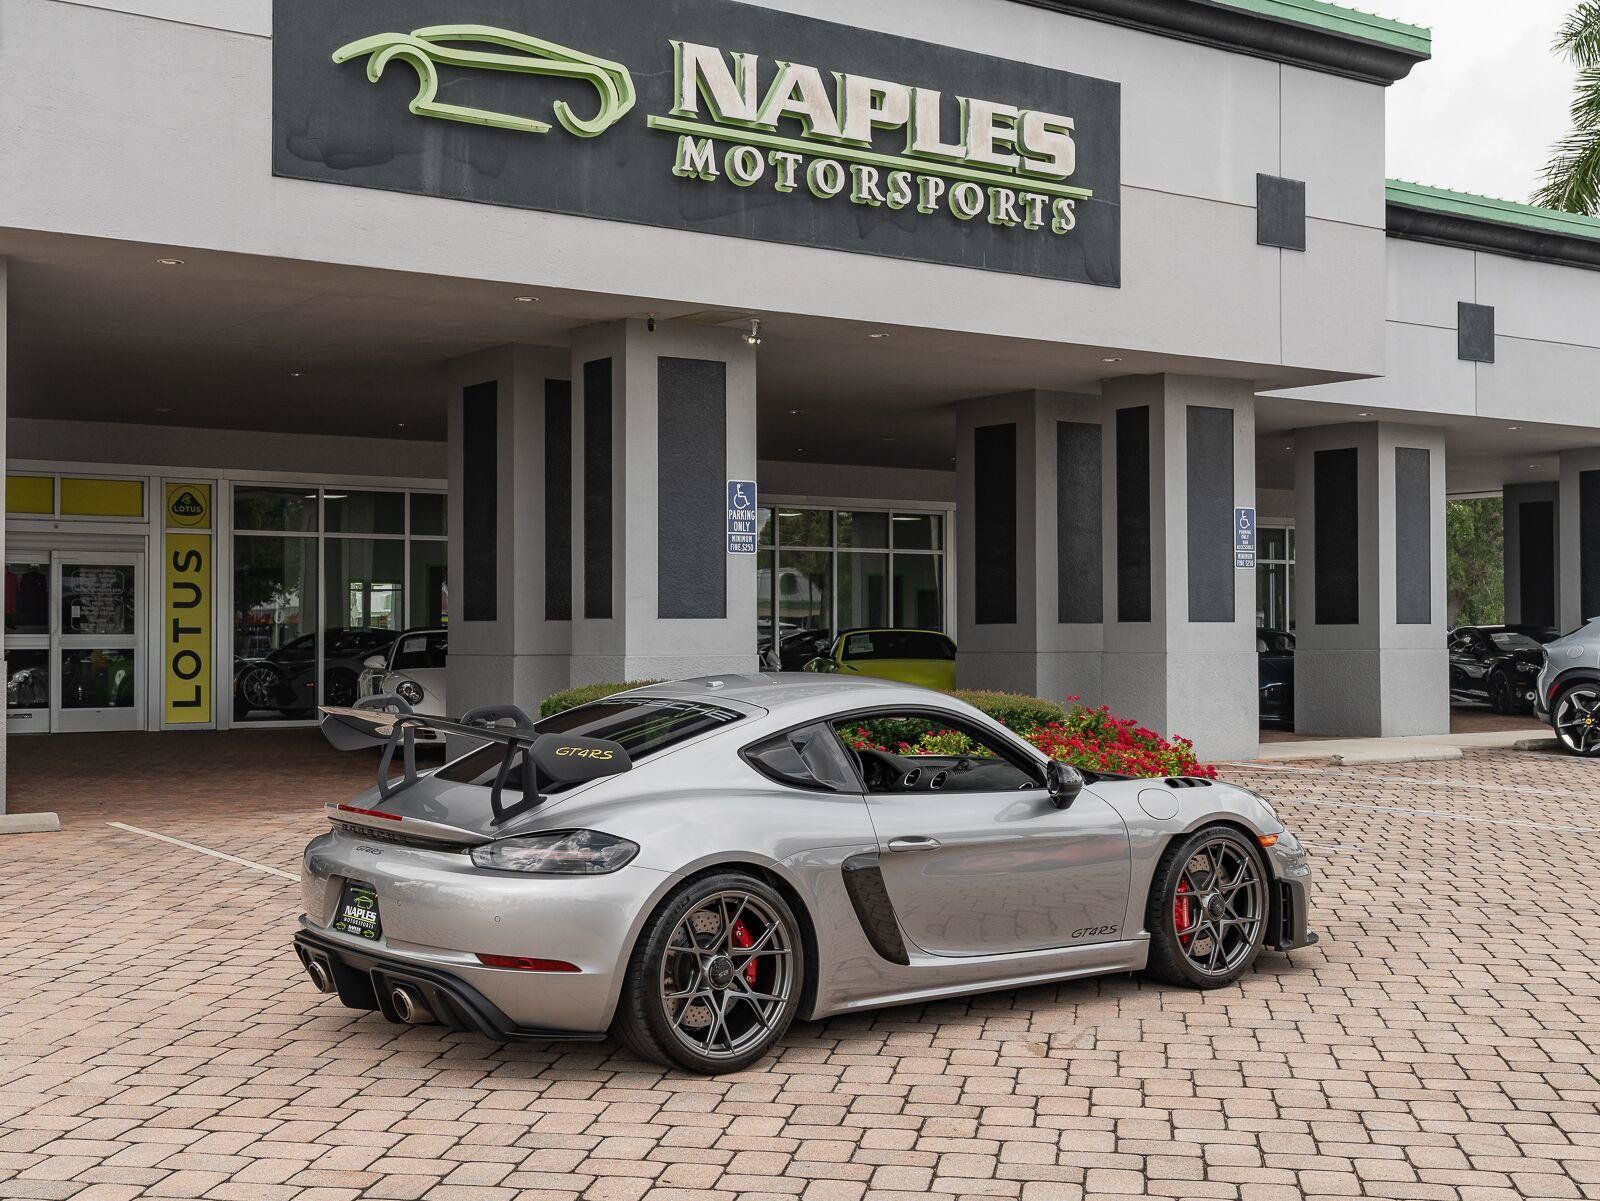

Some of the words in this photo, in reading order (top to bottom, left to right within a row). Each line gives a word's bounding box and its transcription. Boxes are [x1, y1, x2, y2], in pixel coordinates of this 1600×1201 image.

[668, 39, 1076, 180] NAPLES
[672, 135, 1076, 235] MOTORSPORTS
[729, 509, 755, 520] PARKING
[733, 521, 750, 532] ONLY
[731, 535, 753, 543] MINIMUM
[730, 543, 742, 551] FINE
[742, 544, 754, 552] $250
[172, 550, 202, 708] LOTUS
[555, 746, 615, 760] GT4RS
[344, 905, 377, 921] NAPLES
[1071, 924, 1119, 938] GT4RS
